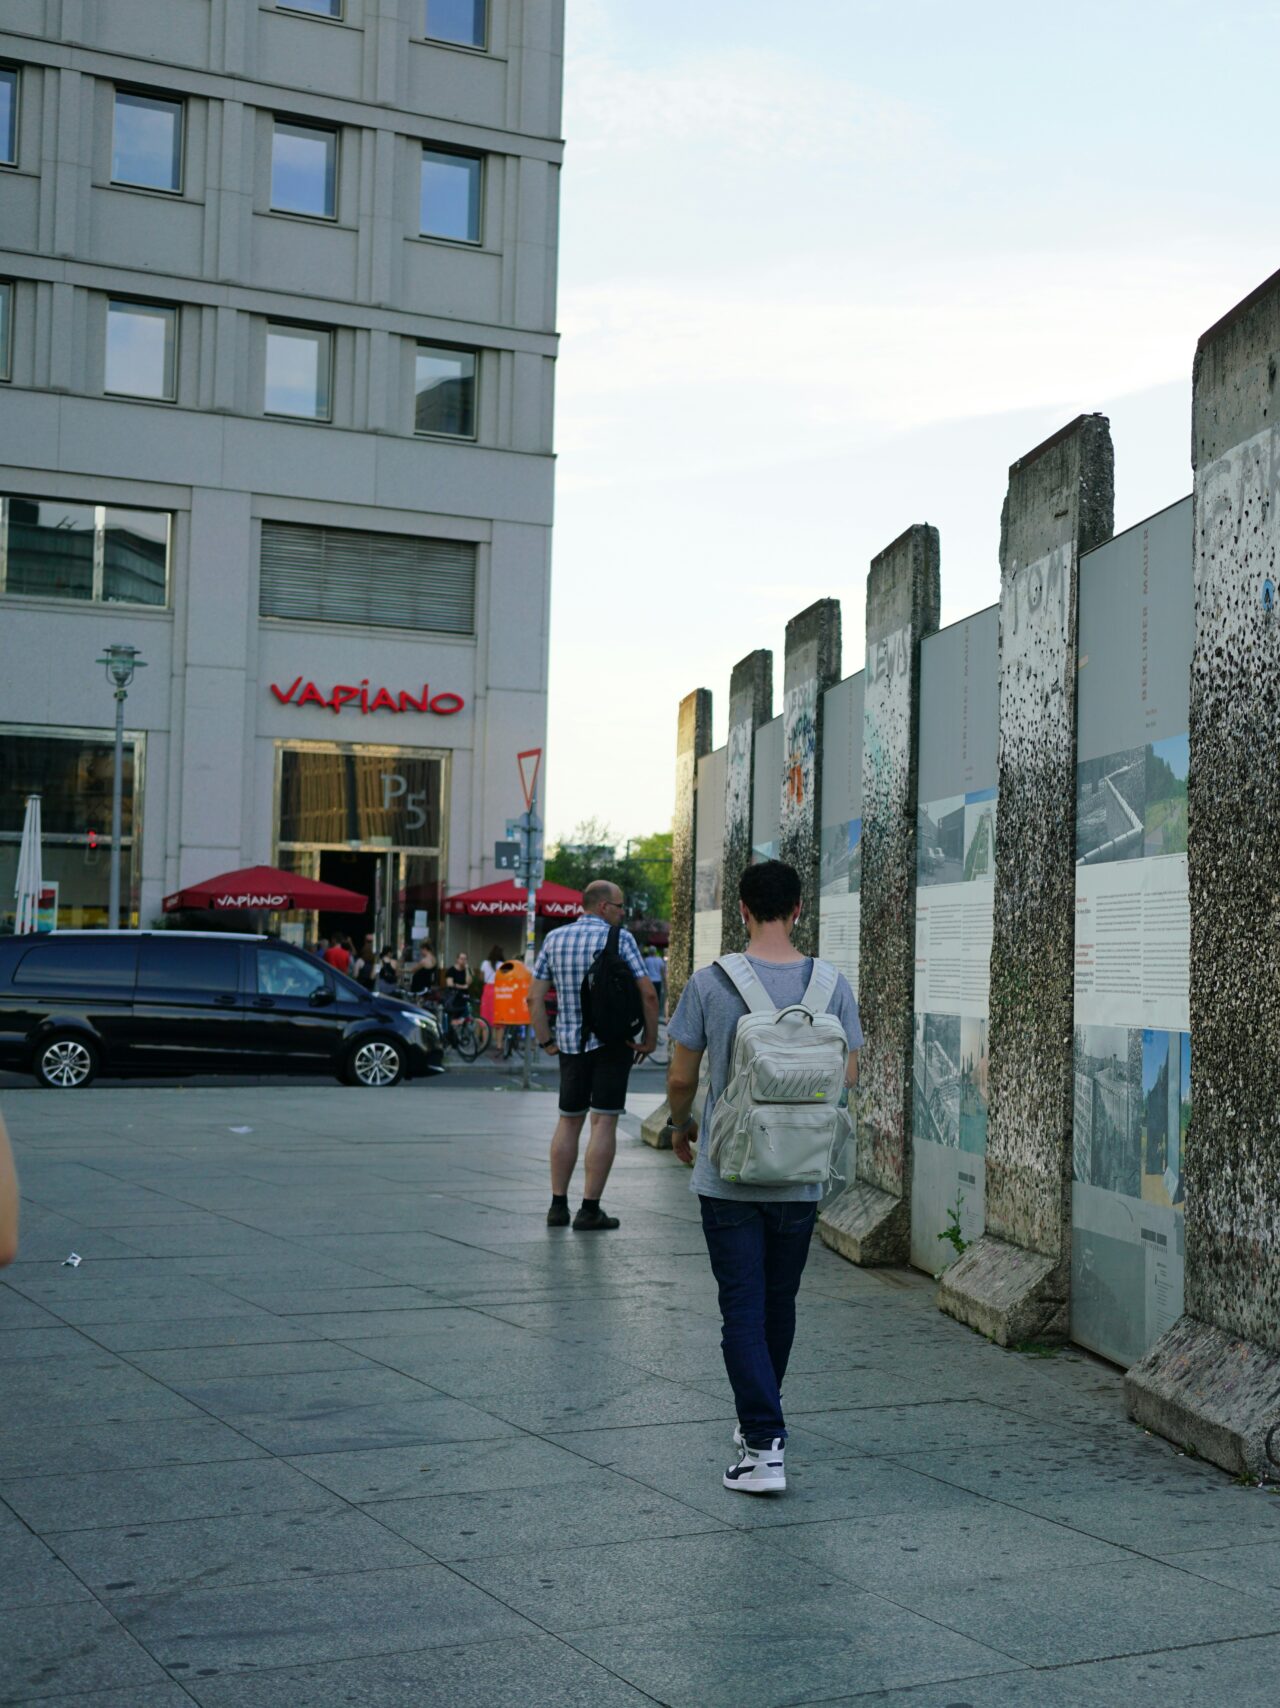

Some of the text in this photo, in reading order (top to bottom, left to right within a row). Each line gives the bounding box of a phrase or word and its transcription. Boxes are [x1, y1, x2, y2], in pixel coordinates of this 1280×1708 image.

[270, 676, 465, 716] VAPIANO
[217, 893, 284, 907] VAPIANO
[546, 902, 585, 915] VAPIA
[761, 1068, 837, 1097] NIKE
